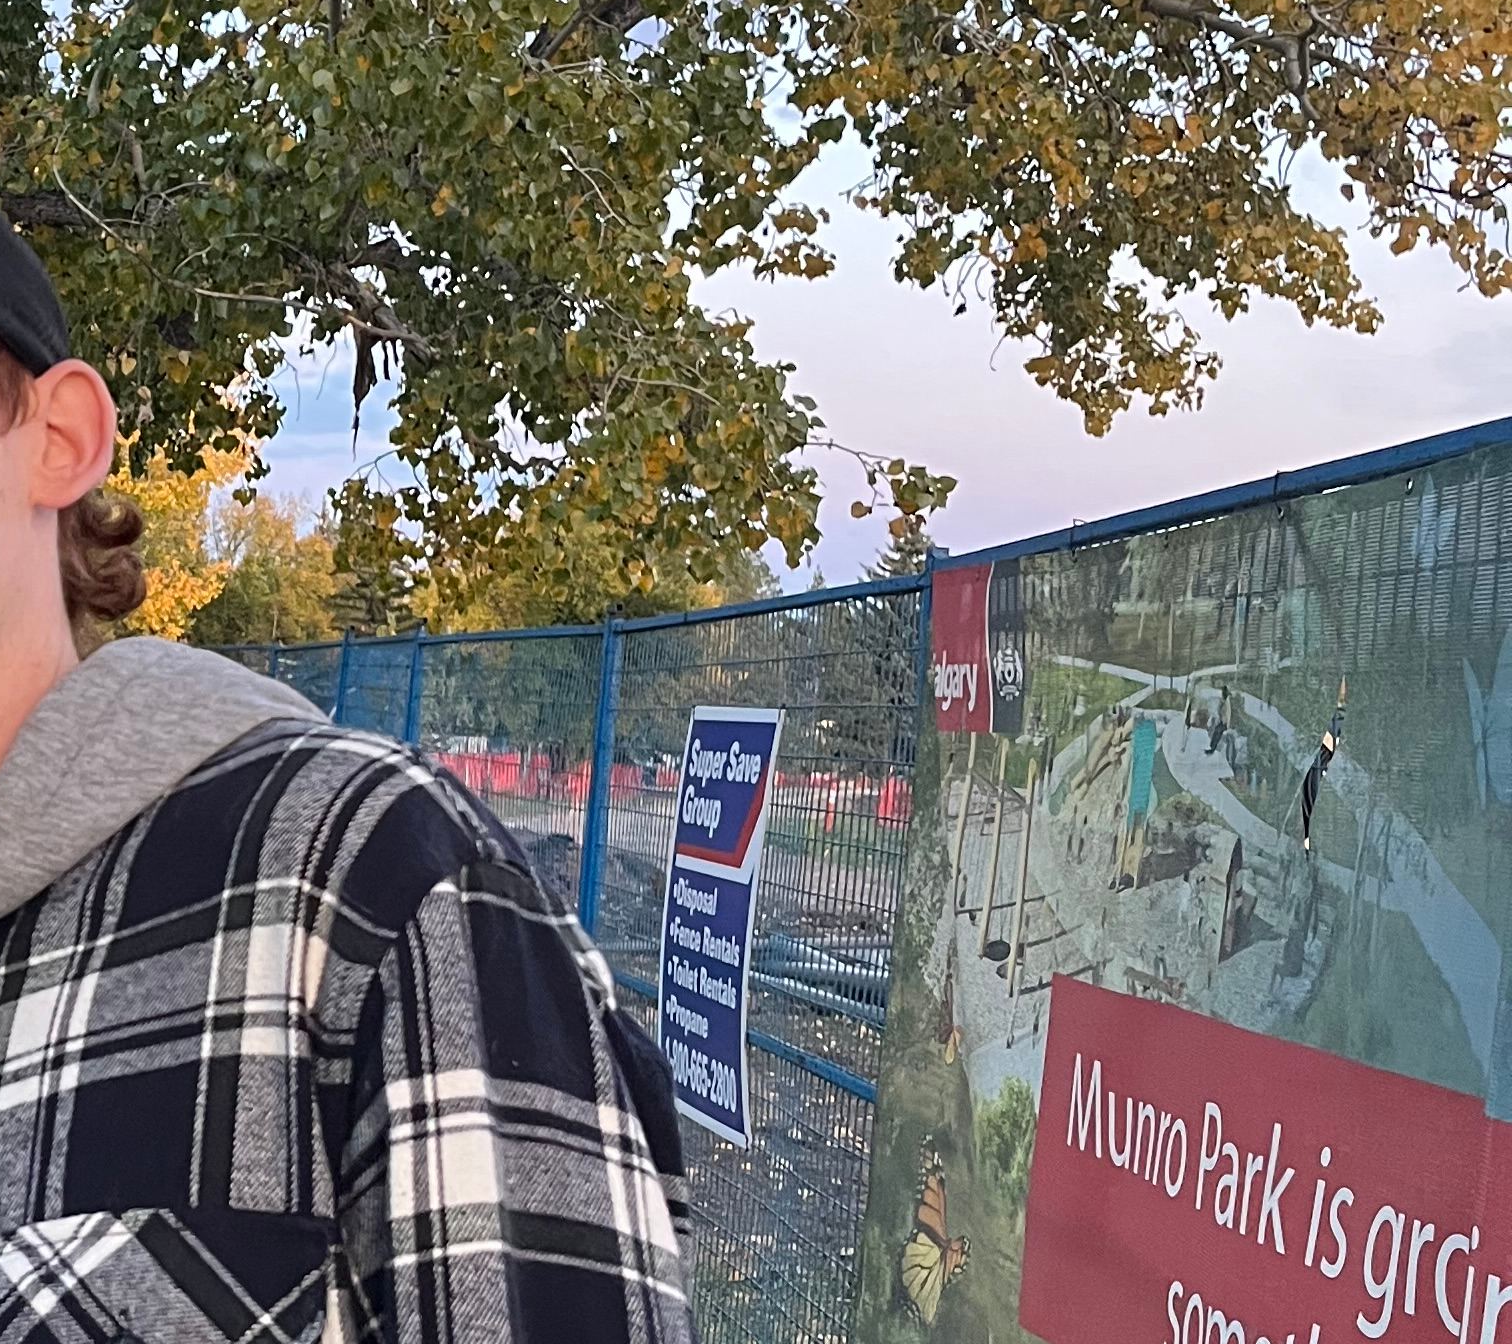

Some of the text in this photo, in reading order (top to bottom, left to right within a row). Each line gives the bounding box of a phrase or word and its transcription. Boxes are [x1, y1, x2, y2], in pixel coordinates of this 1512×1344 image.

[934, 650, 978, 712] algary
[689, 738, 762, 788] Super Save
[682, 784, 722, 839] Group
[702, 925, 740, 967] Rentals
[699, 966, 737, 1010] Rentals
[1066, 1052, 1188, 1198] Munro
[1195, 1101, 1296, 1255] Park
[1303, 1146, 1355, 1279] is
